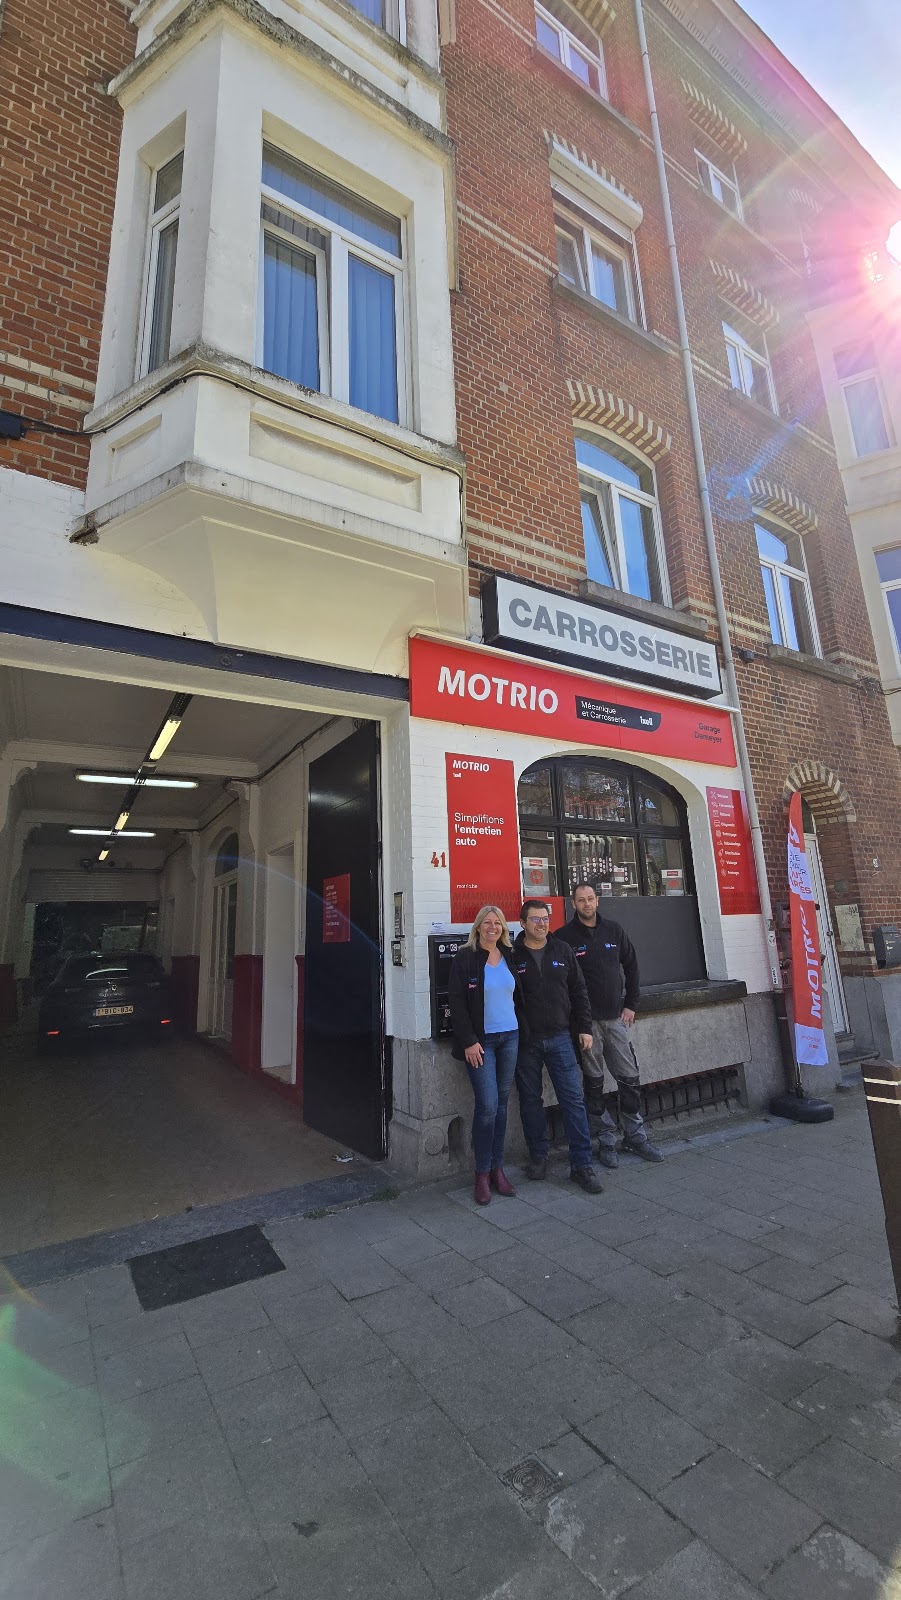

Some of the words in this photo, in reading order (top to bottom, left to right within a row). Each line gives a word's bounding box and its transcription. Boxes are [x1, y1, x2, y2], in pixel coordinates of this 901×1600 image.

[508, 598, 713, 678] CARROSSERIE
[437, 666, 559, 714] MOTRIO
[581, 700, 617, 715] Mécanique
[581, 710, 589, 718] et
[698, 722, 721, 734] Garage
[452, 759, 490, 772] MOTRIO
[454, 812, 505, 825] Simplifions
[454, 824, 502, 836] l'entretien
[455, 837, 477, 846] auto
[430, 851, 447, 868] 41
